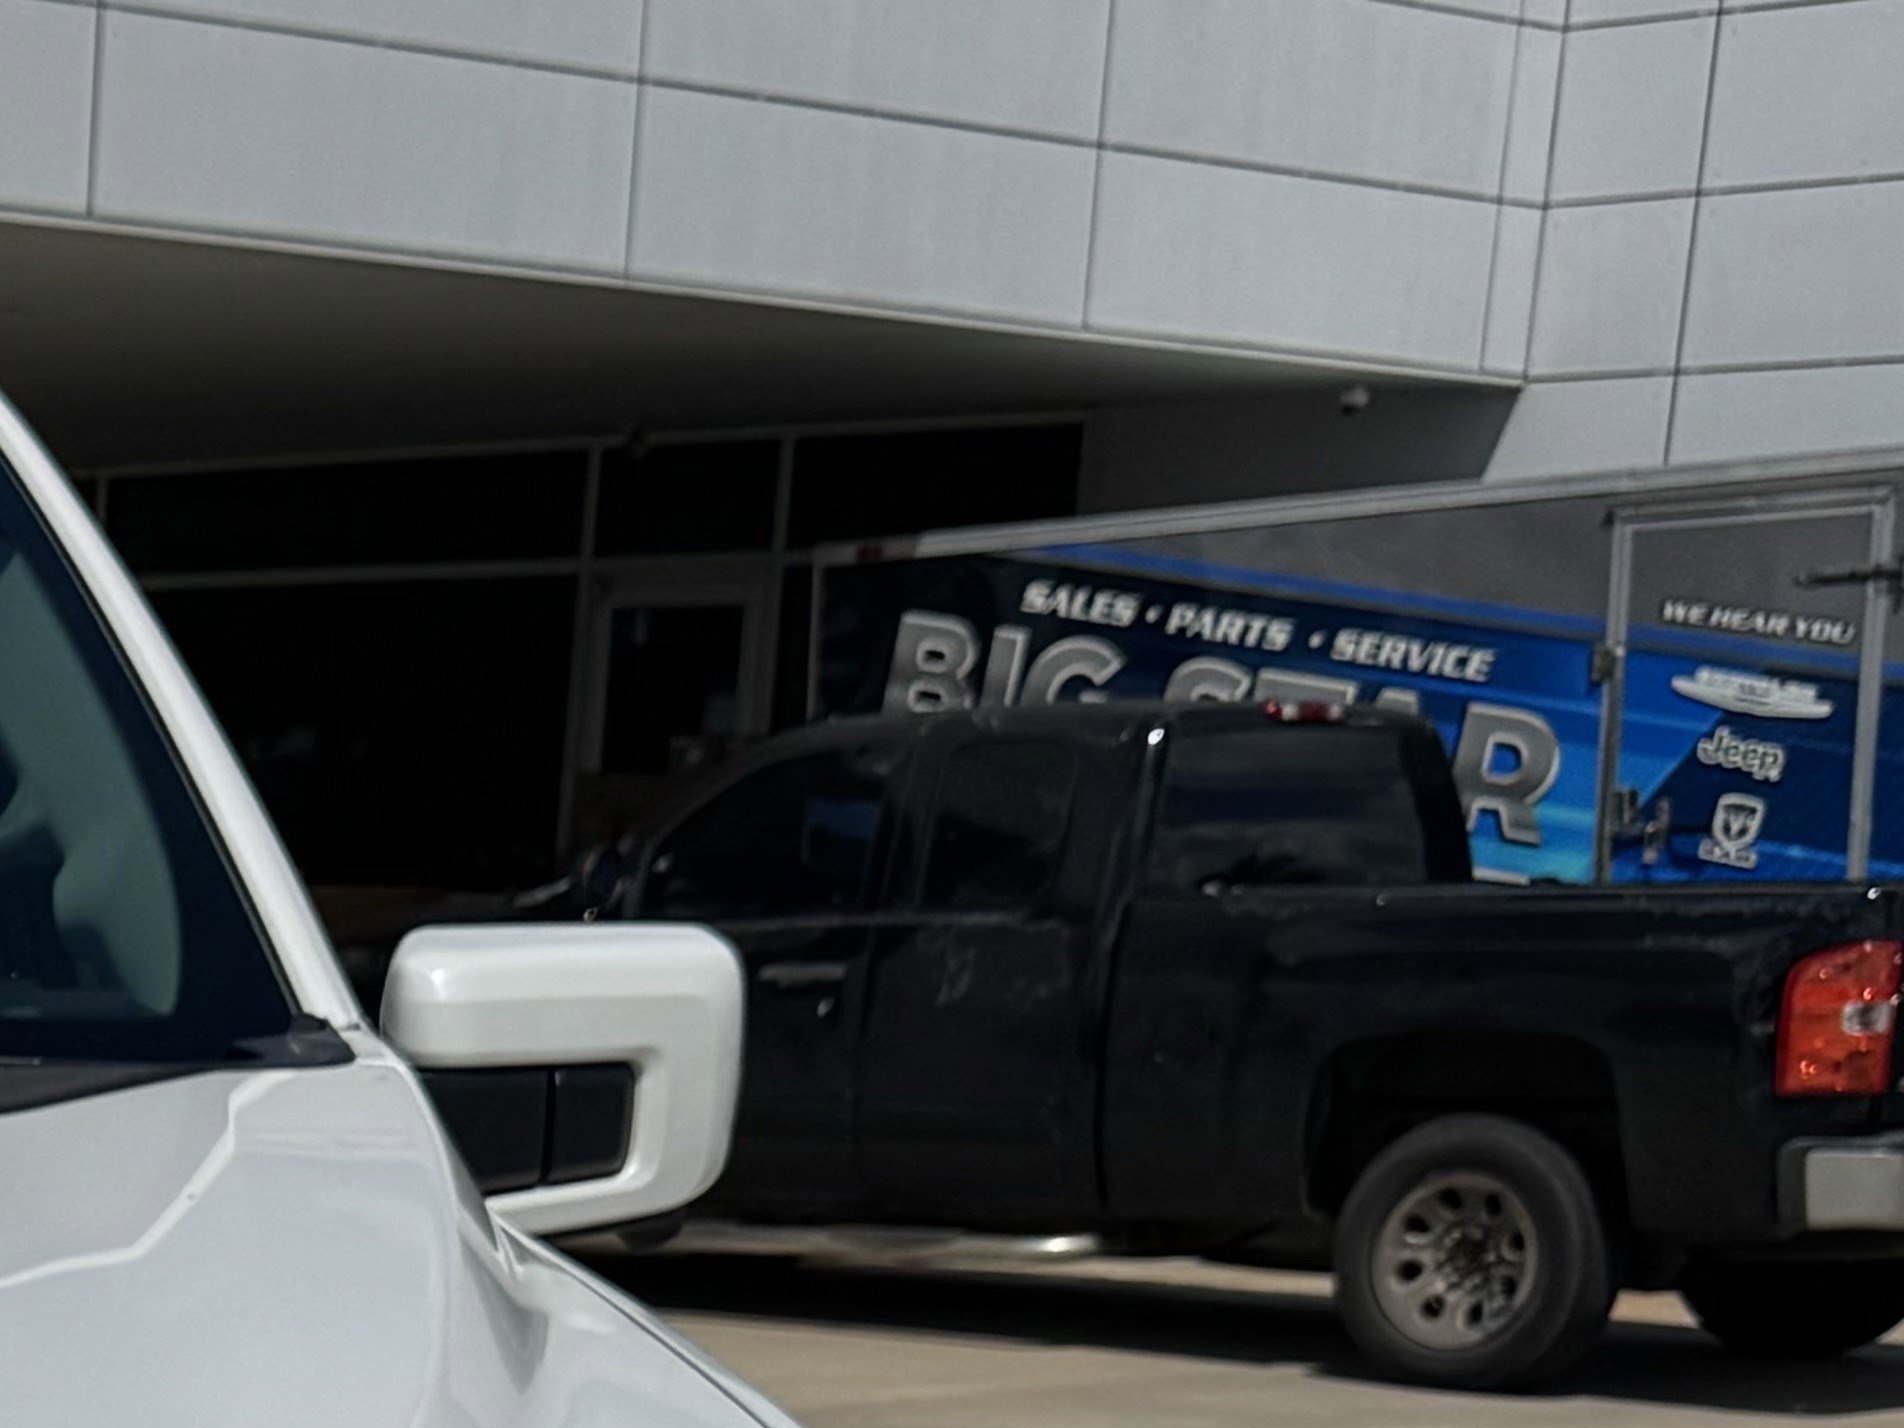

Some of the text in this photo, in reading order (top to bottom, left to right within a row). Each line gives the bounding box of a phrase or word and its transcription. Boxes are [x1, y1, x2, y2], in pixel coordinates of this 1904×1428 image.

[1019, 580, 1497, 682] SALES PARTS SERVICE
[1661, 600, 1857, 645] WE HEAR YOU
[1698, 727, 1787, 781] Jeep
